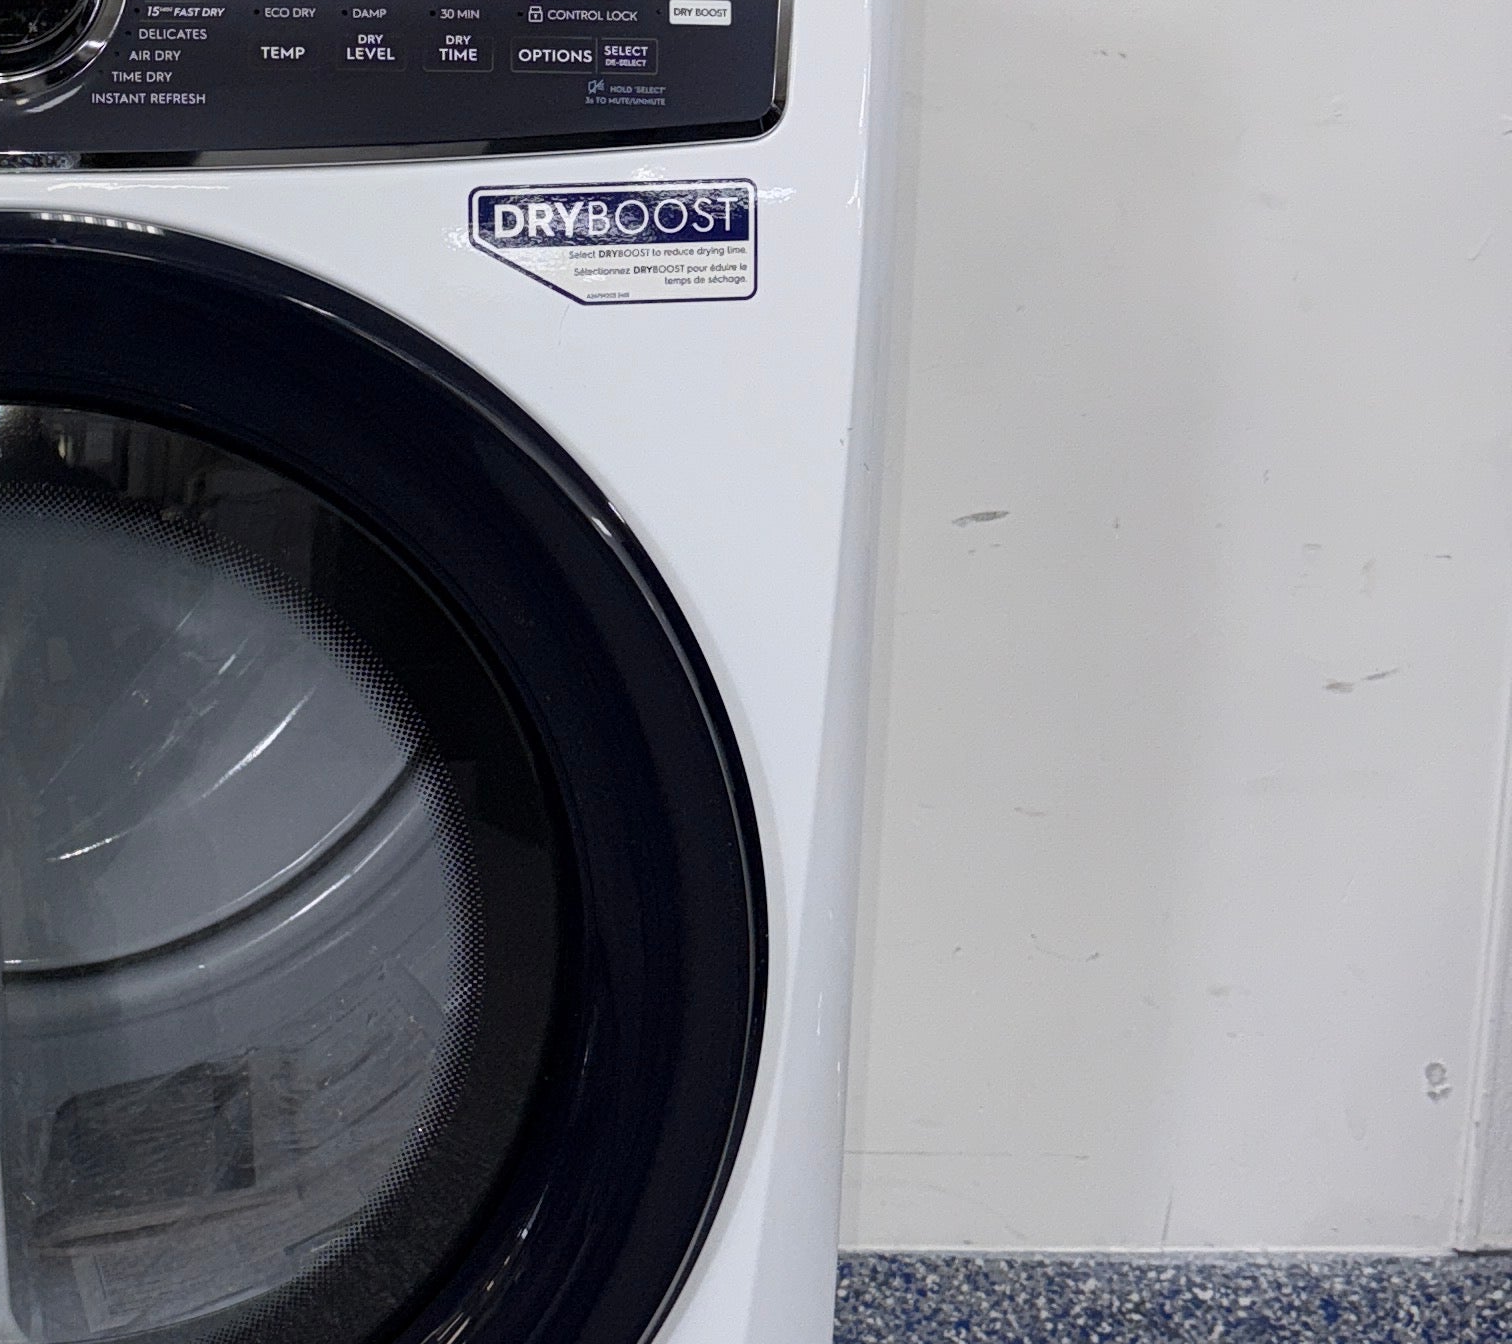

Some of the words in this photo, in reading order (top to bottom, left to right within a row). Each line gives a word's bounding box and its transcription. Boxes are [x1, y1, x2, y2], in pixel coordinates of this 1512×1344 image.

[173, 7, 201, 18] FAST
[201, 7, 227, 18] DRY
[264, 7, 290, 19] ECO
[292, 7, 317, 19] DRY
[351, 7, 388, 19] DAMP
[439, 8, 455, 20] 30
[456, 8, 481, 20] MIN
[547, 8, 605, 21] CONTROL
[606, 9, 639, 23] LOCK
[672, 6, 694, 19] DRY
[694, 6, 729, 19] BOOST
[138, 28, 208, 41] DELICATES
[357, 33, 384, 46] DRY
[445, 34, 472, 47] DRY
[128, 49, 152, 62] AIR
[154, 50, 183, 63] DRY
[260, 45, 307, 61] TEMP
[346, 47, 396, 62] LEVEL
[438, 48, 478, 63] TIME
[517, 47, 593, 64] OPTIONS
[604, 44, 649, 57] SELECT
[111, 71, 143, 83] TIME
[146, 71, 173, 84] DRY
[609, 85, 633, 95] HOLD
[90, 92, 147, 105] INSTANT
[150, 93, 207, 105] REFRESH
[493, 197, 739, 239] DRYBOOST
[569, 249, 597, 260] Select
[598, 247, 651, 259] DRYBOOST
[652, 247, 662, 258] to
[663, 246, 695, 257] reduce
[696, 245, 726, 259] drying
[633, 264, 685, 275] DRYBOOST
[687, 265, 708, 276] pour
[664, 275, 692, 287] temps
[693, 274, 706, 285] de
